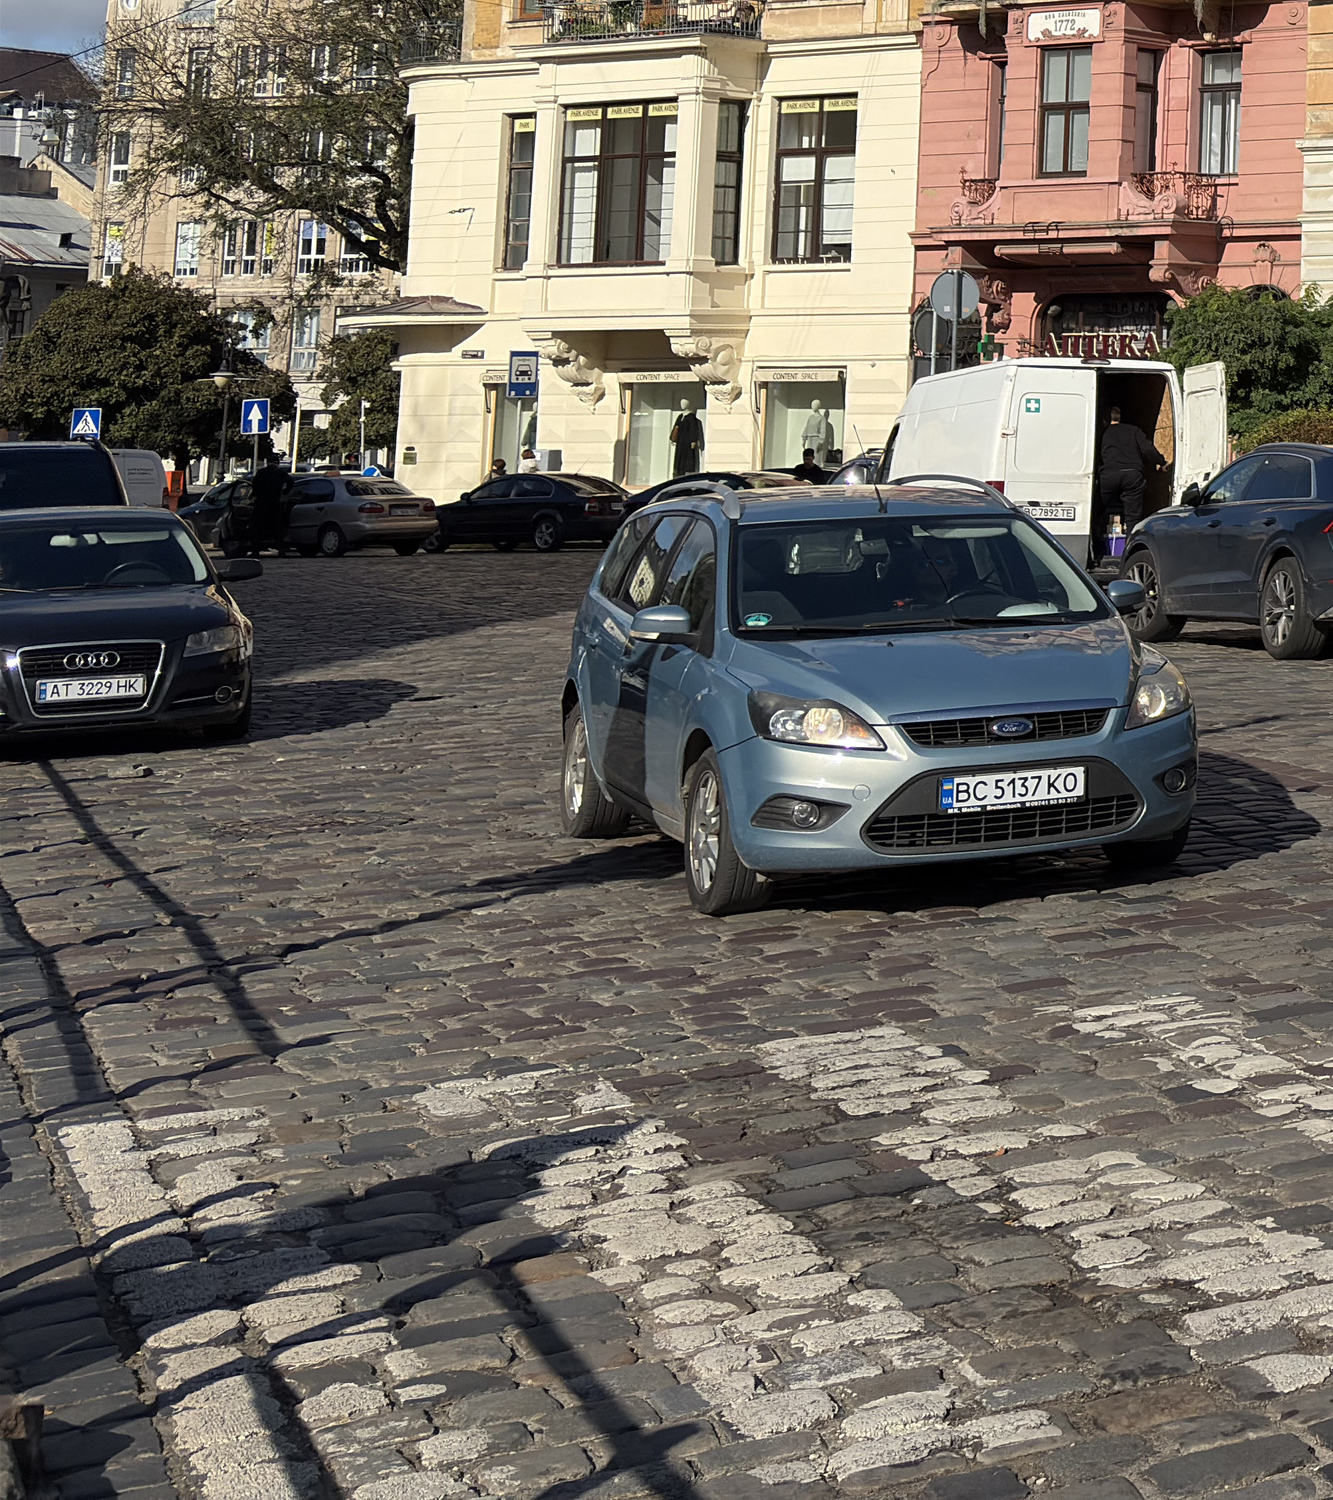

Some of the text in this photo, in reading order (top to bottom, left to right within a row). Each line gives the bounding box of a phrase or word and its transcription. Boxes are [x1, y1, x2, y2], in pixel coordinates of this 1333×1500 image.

[1054, 18, 1076, 32] 1772
[786, 101, 816, 110] PARK AVENUE
[828, 99, 858, 108] PARK AVENUE
[1042, 331, 1161, 358] АПТЕКА
[636, 373, 660, 381] CONTENT
[772, 372, 818, 380] CONTENT SPACE
[1039, 508, 1059, 517] 7892
[1061, 508, 1073, 518] TE
[50, 678, 139, 698] AT 3229 HK
[1002, 722, 1024, 732] Ford
[955, 771, 1078, 803] BC 5137 KO
